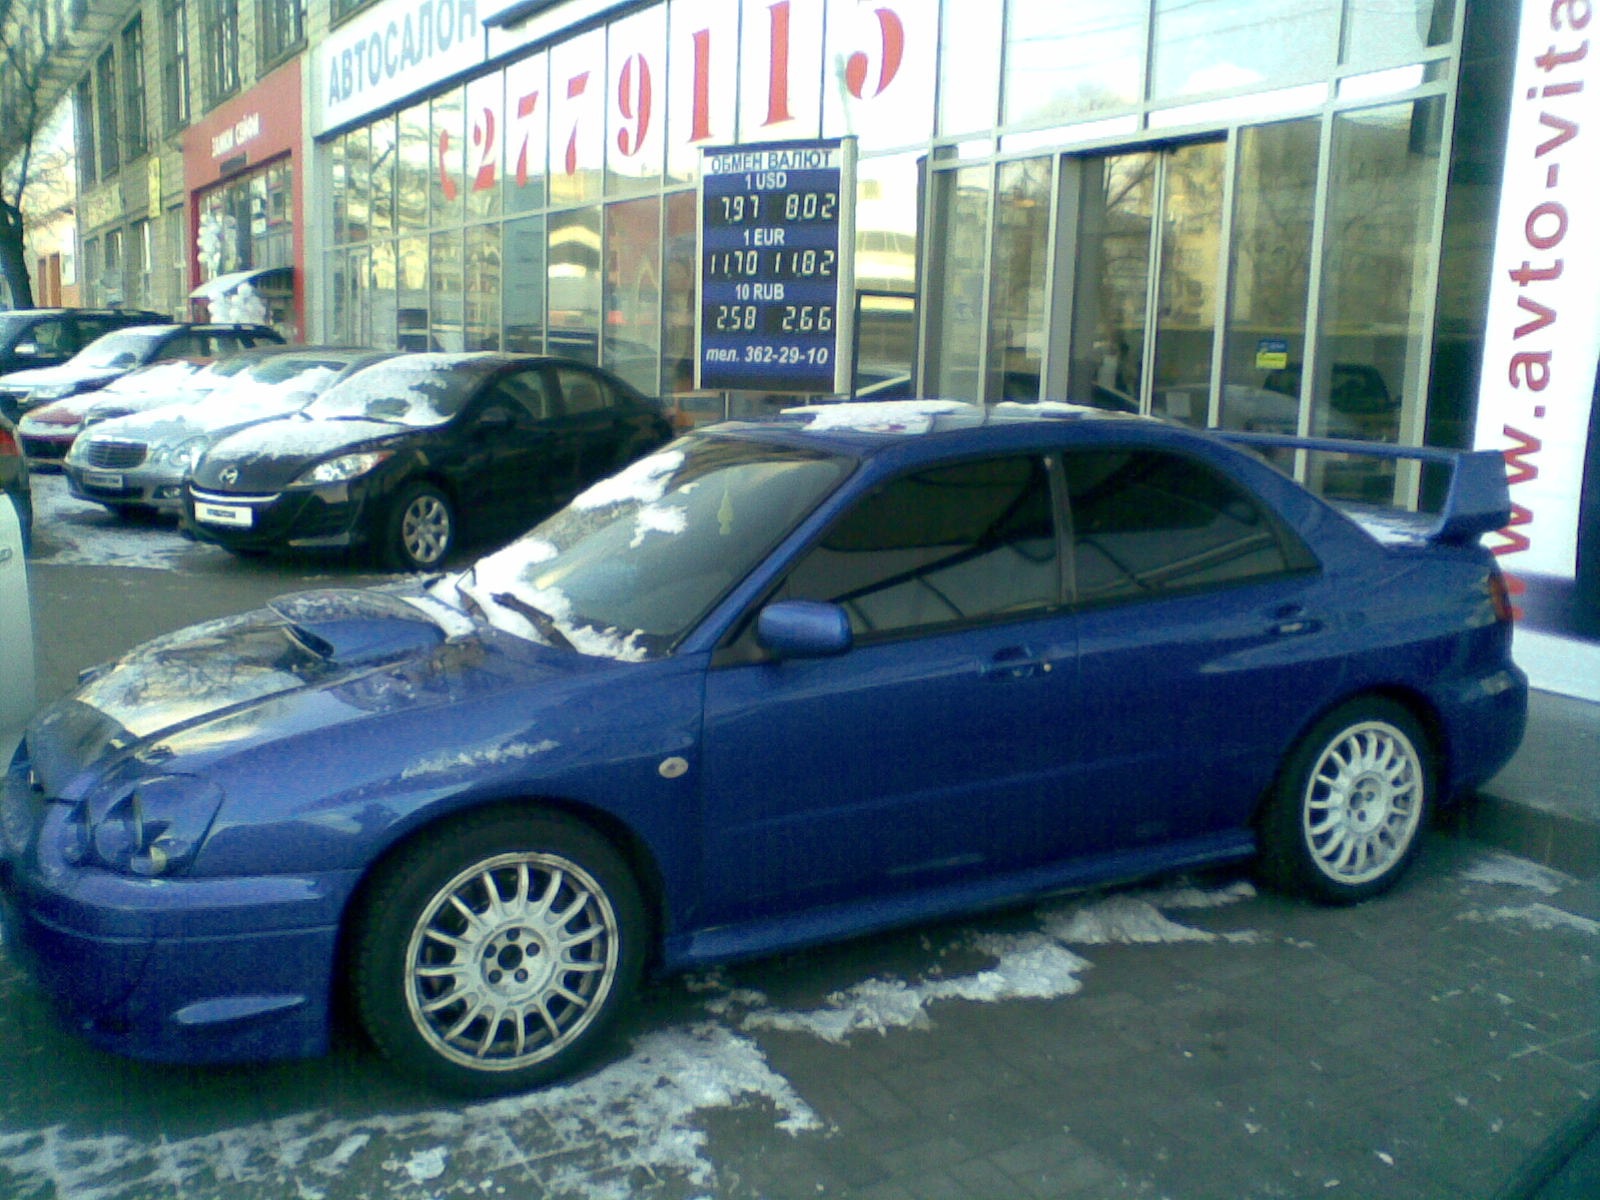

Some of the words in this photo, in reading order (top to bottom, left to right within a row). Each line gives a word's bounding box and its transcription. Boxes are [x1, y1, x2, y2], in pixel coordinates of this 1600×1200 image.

[329, 0, 477, 107] АВТОСАЛОН
[711, 152, 763, 174] ОБМЕН
[767, 149, 832, 169] ВАЛЮТ
[745, 174, 751, 190] 1
[756, 173, 787, 190] USD
[743, 229, 750, 247] 1
[754, 228, 785, 247] EUR
[735, 284, 750, 300] 10
[753, 283, 785, 300] RUB
[1488, 0, 1593, 621] ww.avto-vita
[705, 348, 740, 363] тел.
[744, 347, 828, 365] 362-29-10
